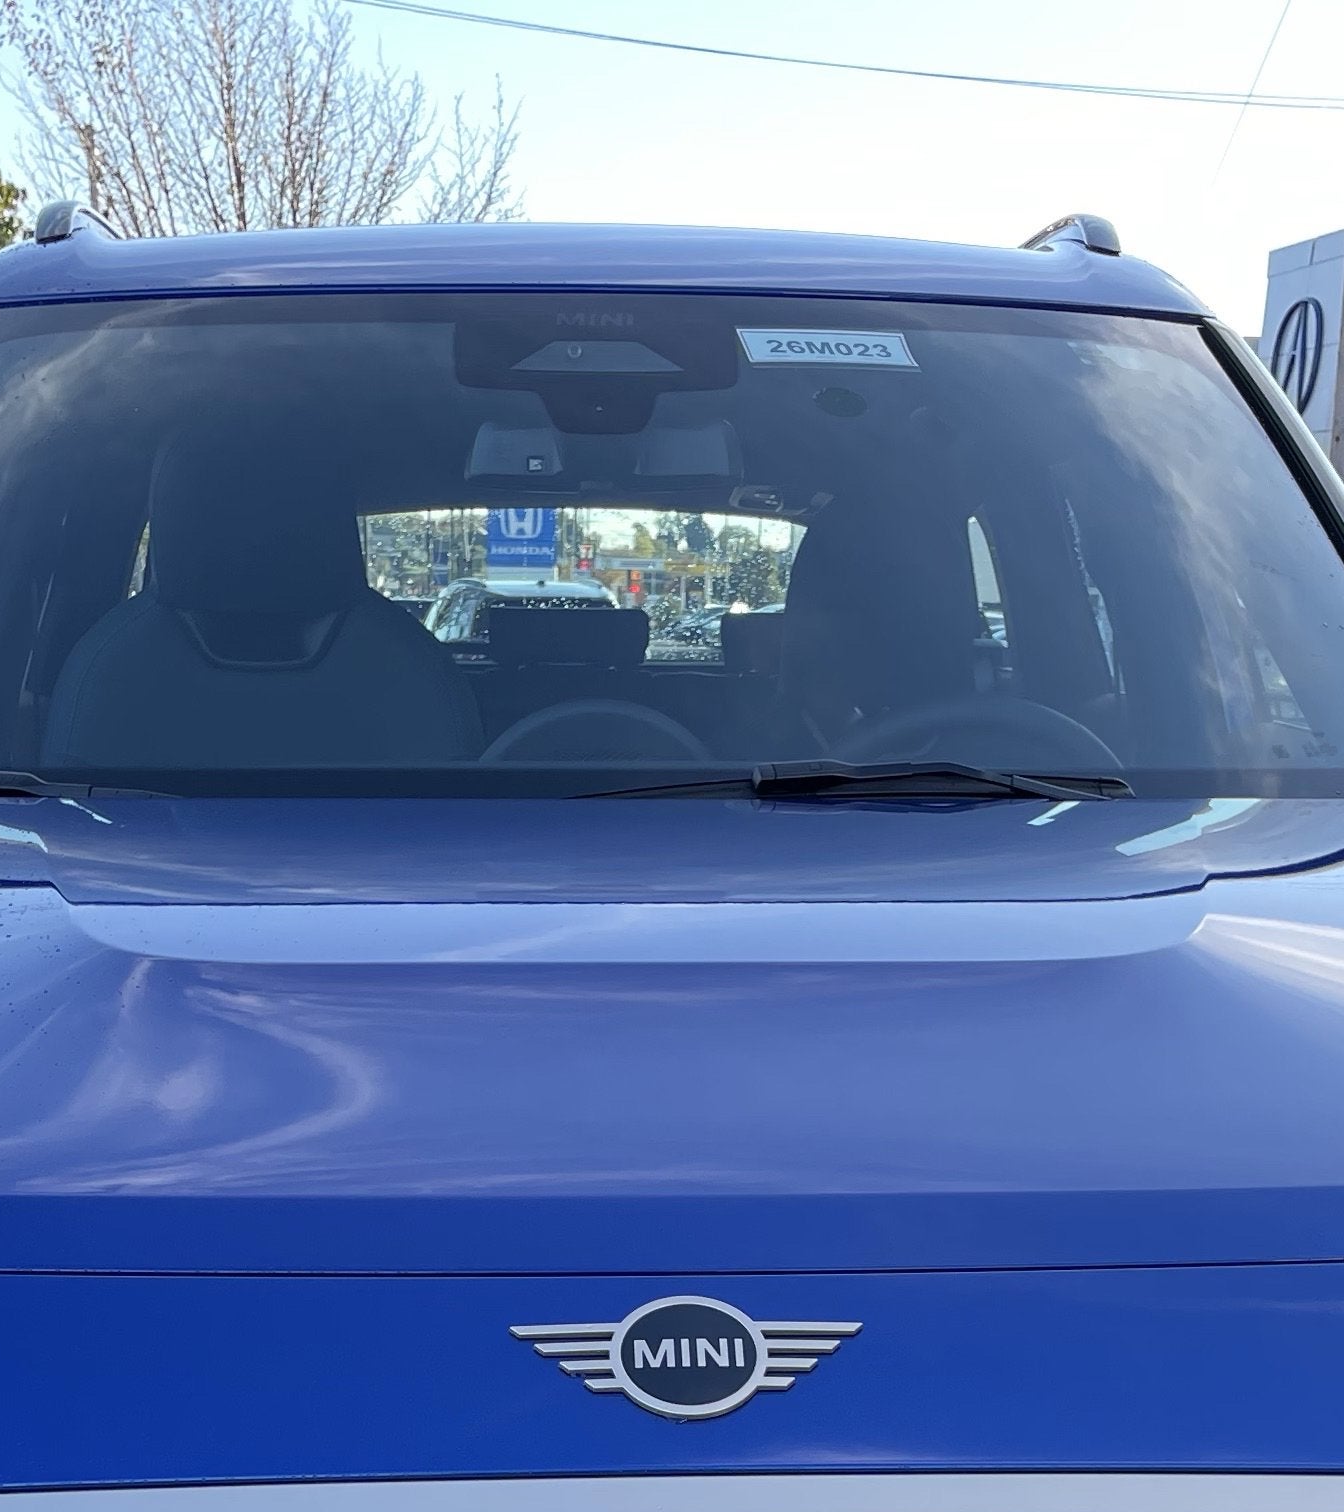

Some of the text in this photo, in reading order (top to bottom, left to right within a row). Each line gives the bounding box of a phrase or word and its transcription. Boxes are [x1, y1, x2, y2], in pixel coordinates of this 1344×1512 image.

[765, 339, 893, 359] 26M023
[490, 545, 554, 556] HONDA
[633, 1337, 746, 1369] MINI
